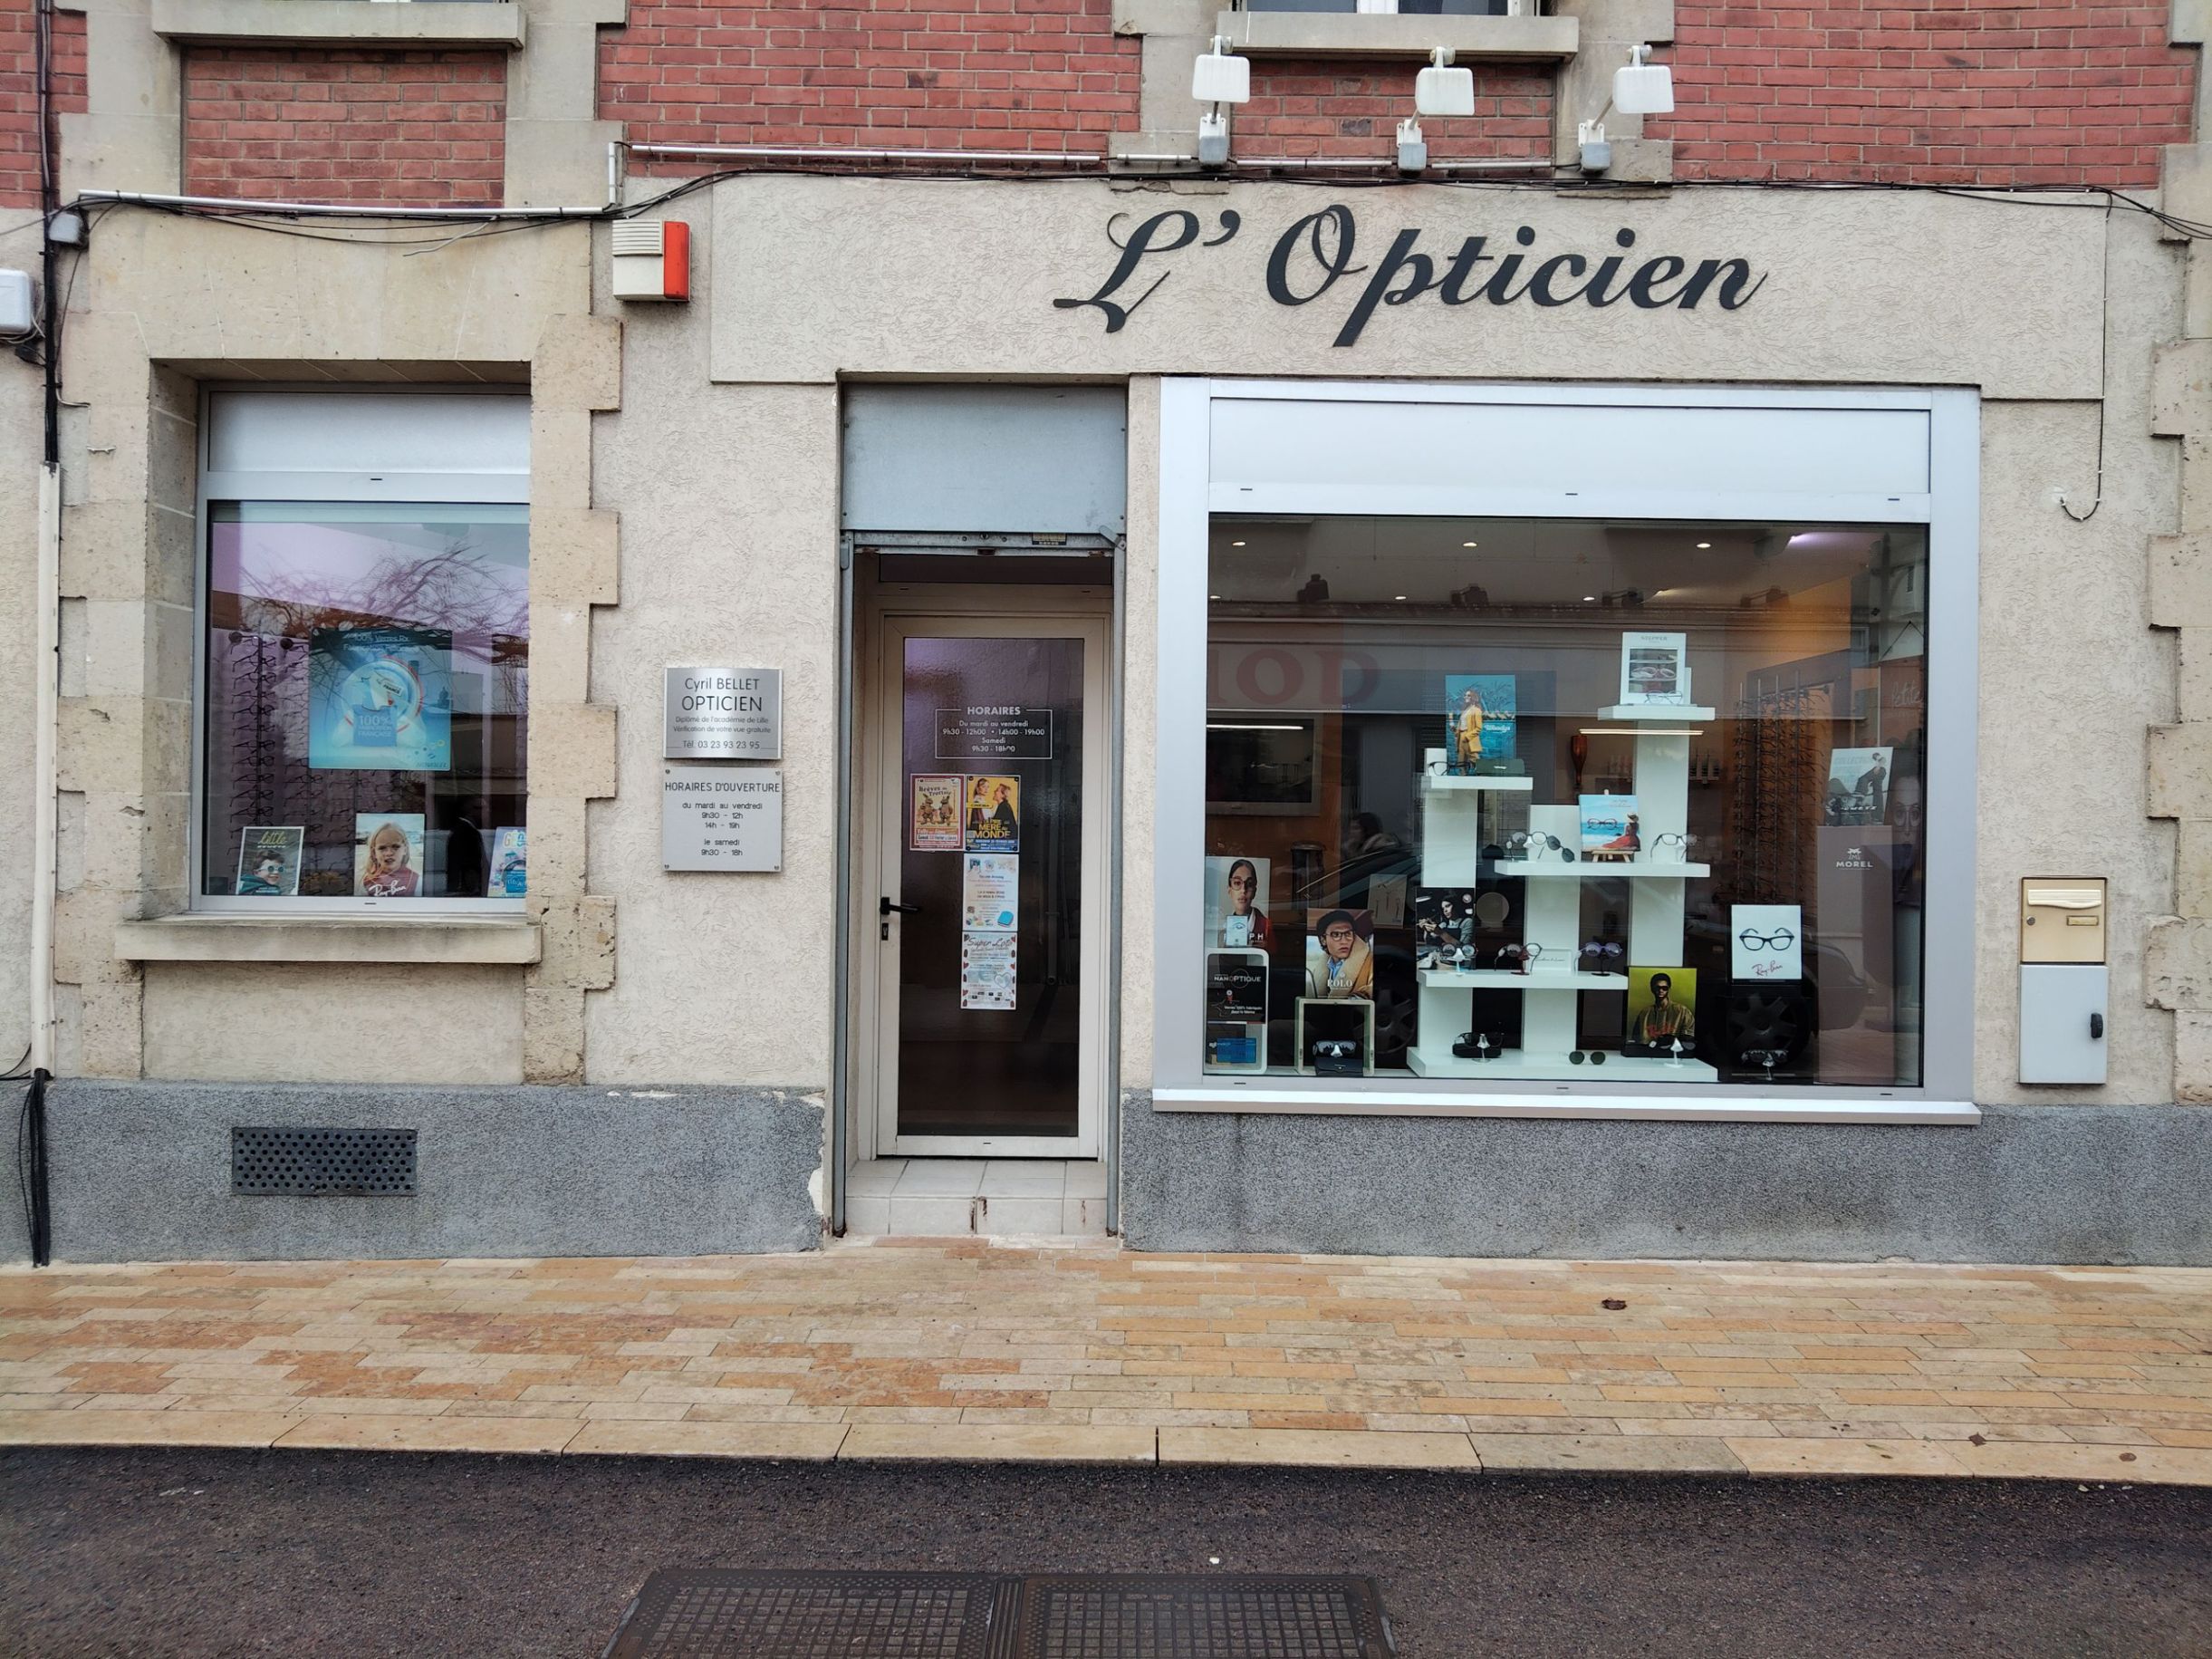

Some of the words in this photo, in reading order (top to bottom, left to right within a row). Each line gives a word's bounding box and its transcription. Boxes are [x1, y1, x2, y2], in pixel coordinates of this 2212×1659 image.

[1265, 204, 1769, 347] Opticien
[685, 677, 712, 692] Cyril
[716, 678, 760, 690] BELLET
[681, 695, 763, 711] OPTICIEN
[967, 706, 1021, 716] HORAIRES
[746, 716, 756, 724] de
[756, 716, 769, 724] Lille
[746, 726, 772, 734] gratuite
[697, 740, 708, 748] 03
[710, 740, 721, 748] 23
[736, 741, 746, 749] 23
[749, 741, 760, 749] 95
[665, 782, 713, 791] HORAIRES
[715, 783, 781, 793] D'OUVERTURE
[975, 830, 1011, 839] MONDE
[1751, 960, 1783, 977] Ray-Ban
[1327, 979, 1353, 988] POLO
